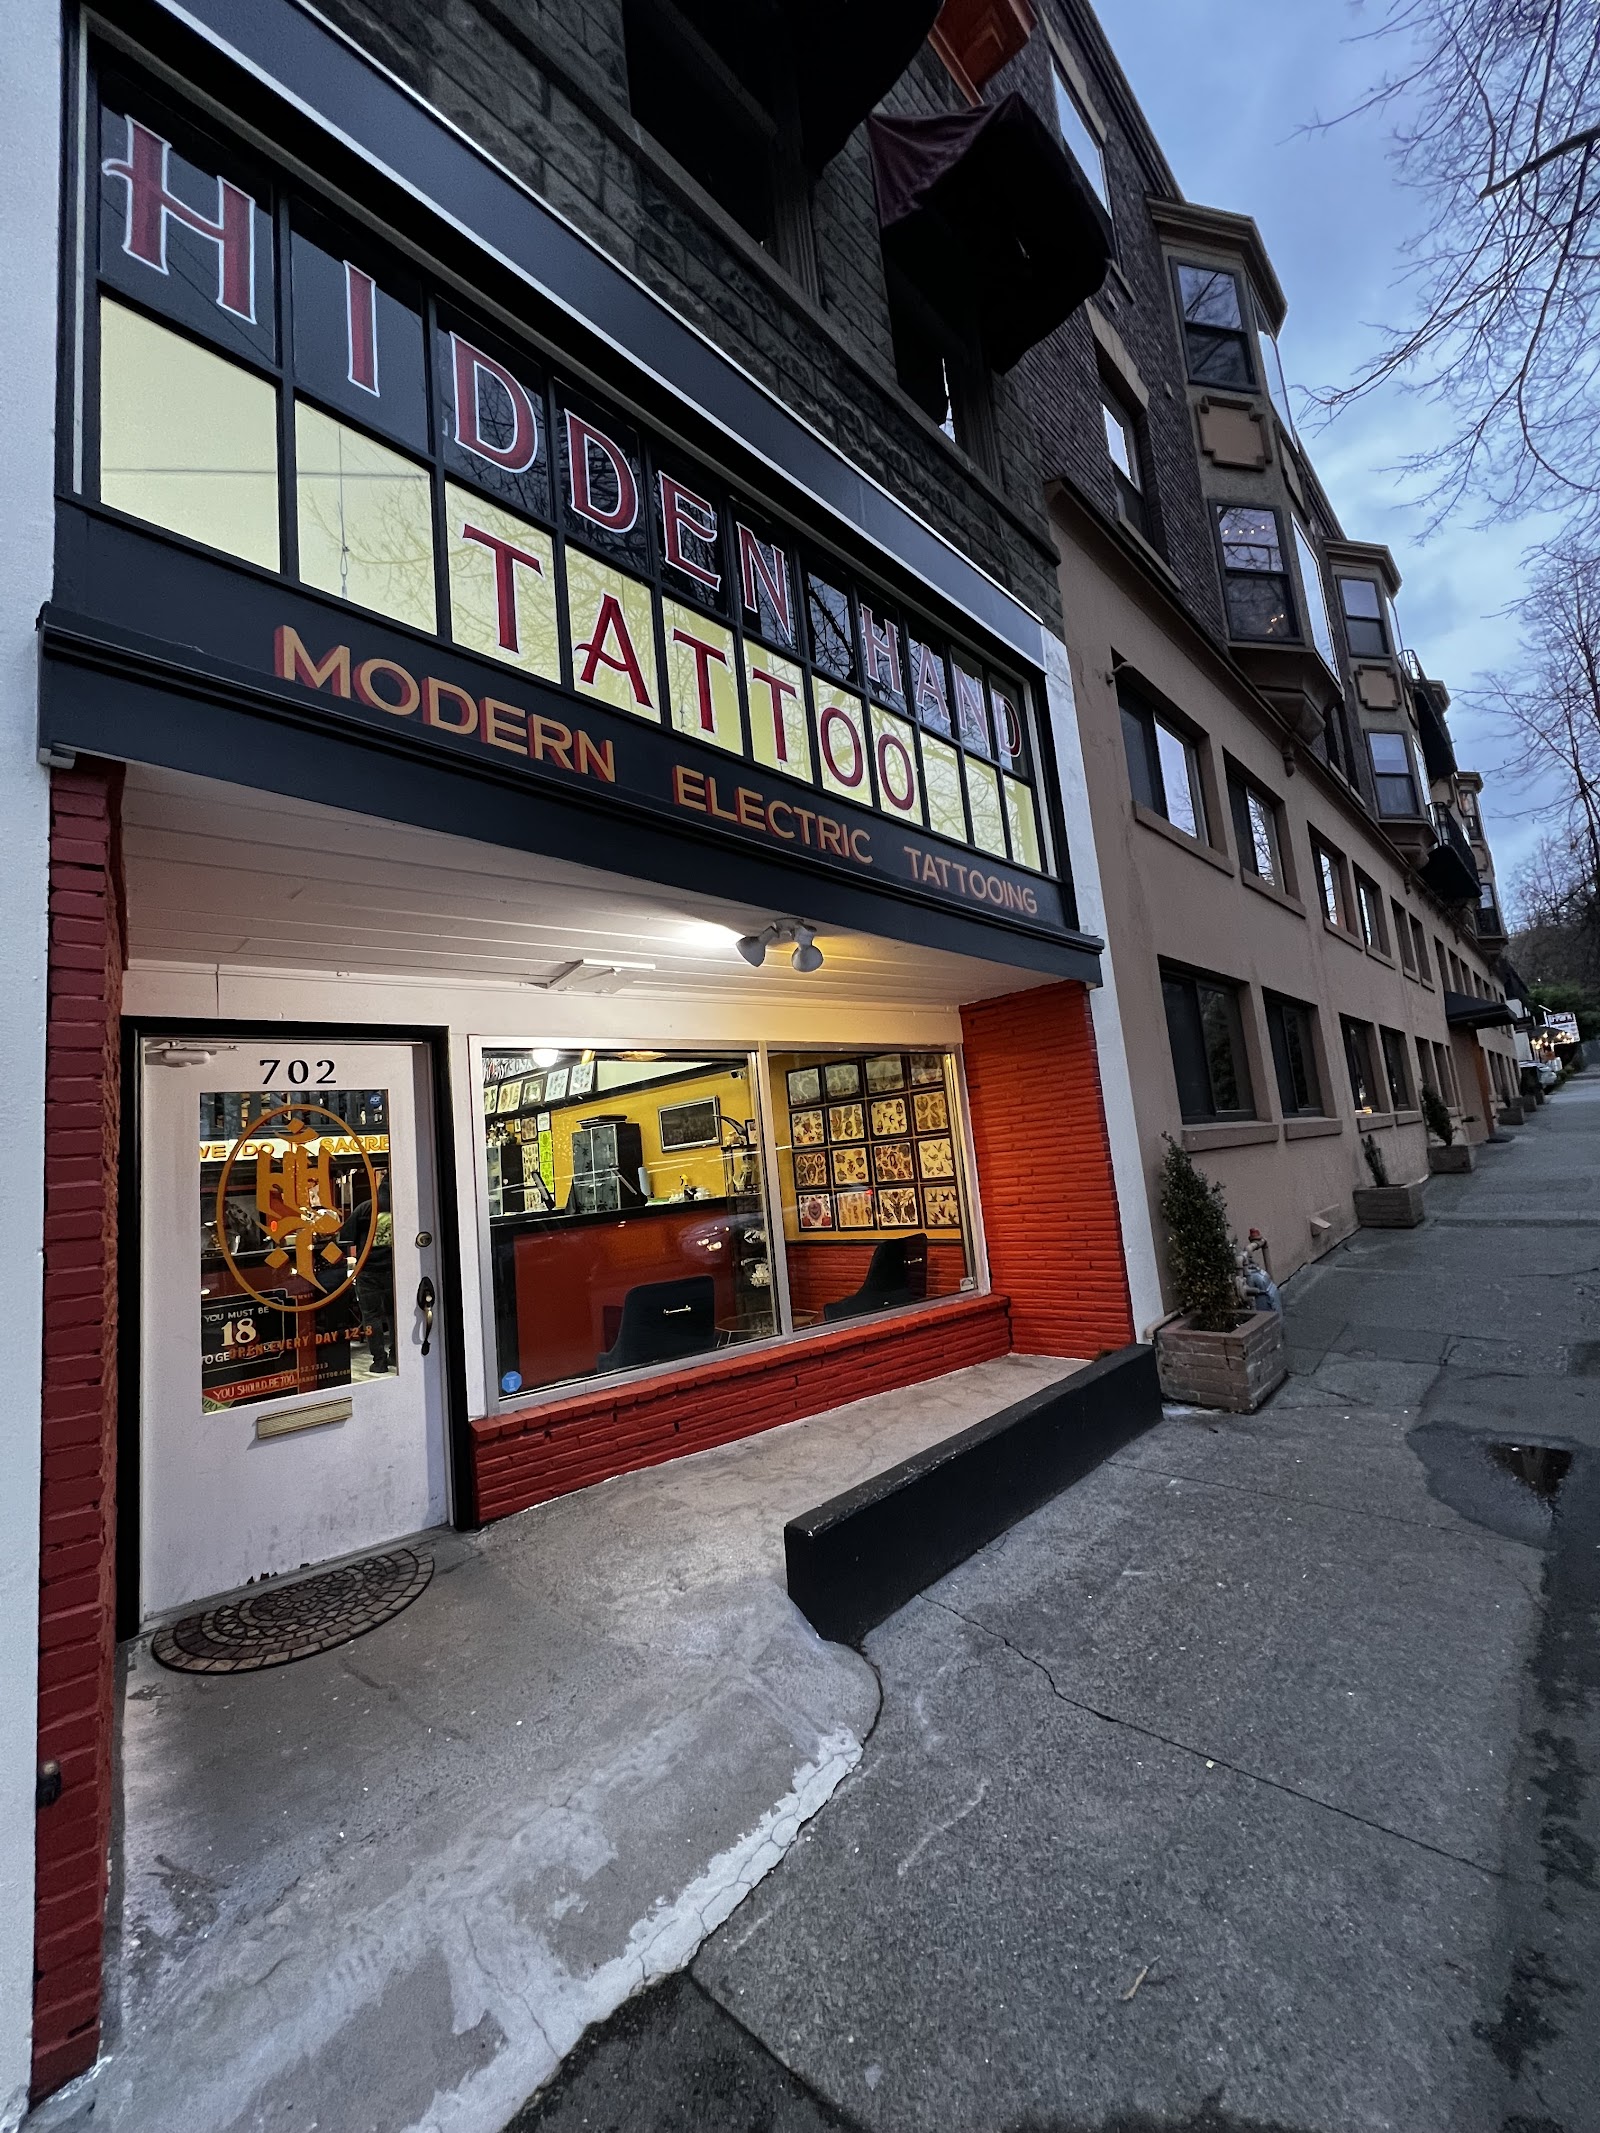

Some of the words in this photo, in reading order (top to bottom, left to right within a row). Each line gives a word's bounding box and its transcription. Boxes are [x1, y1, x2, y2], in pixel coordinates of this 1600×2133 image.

[102, 113, 793, 645] HIDDEN
[860, 603, 1022, 759] HAND
[462, 522, 917, 812] TATTOO
[273, 624, 616, 783] MODERN
[672, 764, 874, 865] ELECTRIC
[903, 845, 1038, 915] TATTOOING
[259, 1059, 337, 1085] 702
[242, 1143, 274, 1157] DO
[204, 1313, 224, 1323] YOU
[227, 1308, 254, 1319] MUST
[258, 1306, 270, 1314] BE
[220, 1317, 257, 1347] 18
[229, 1343, 265, 1359] OPEN
[269, 1336, 309, 1352] EVERY
[315, 1331, 338, 1344] DAY
[344, 1325, 373, 1340] 12-8
[212, 1386, 235, 1400] YOU
[237, 1380, 268, 1396] SHOULD
[268, 1377, 279, 1388] BE
